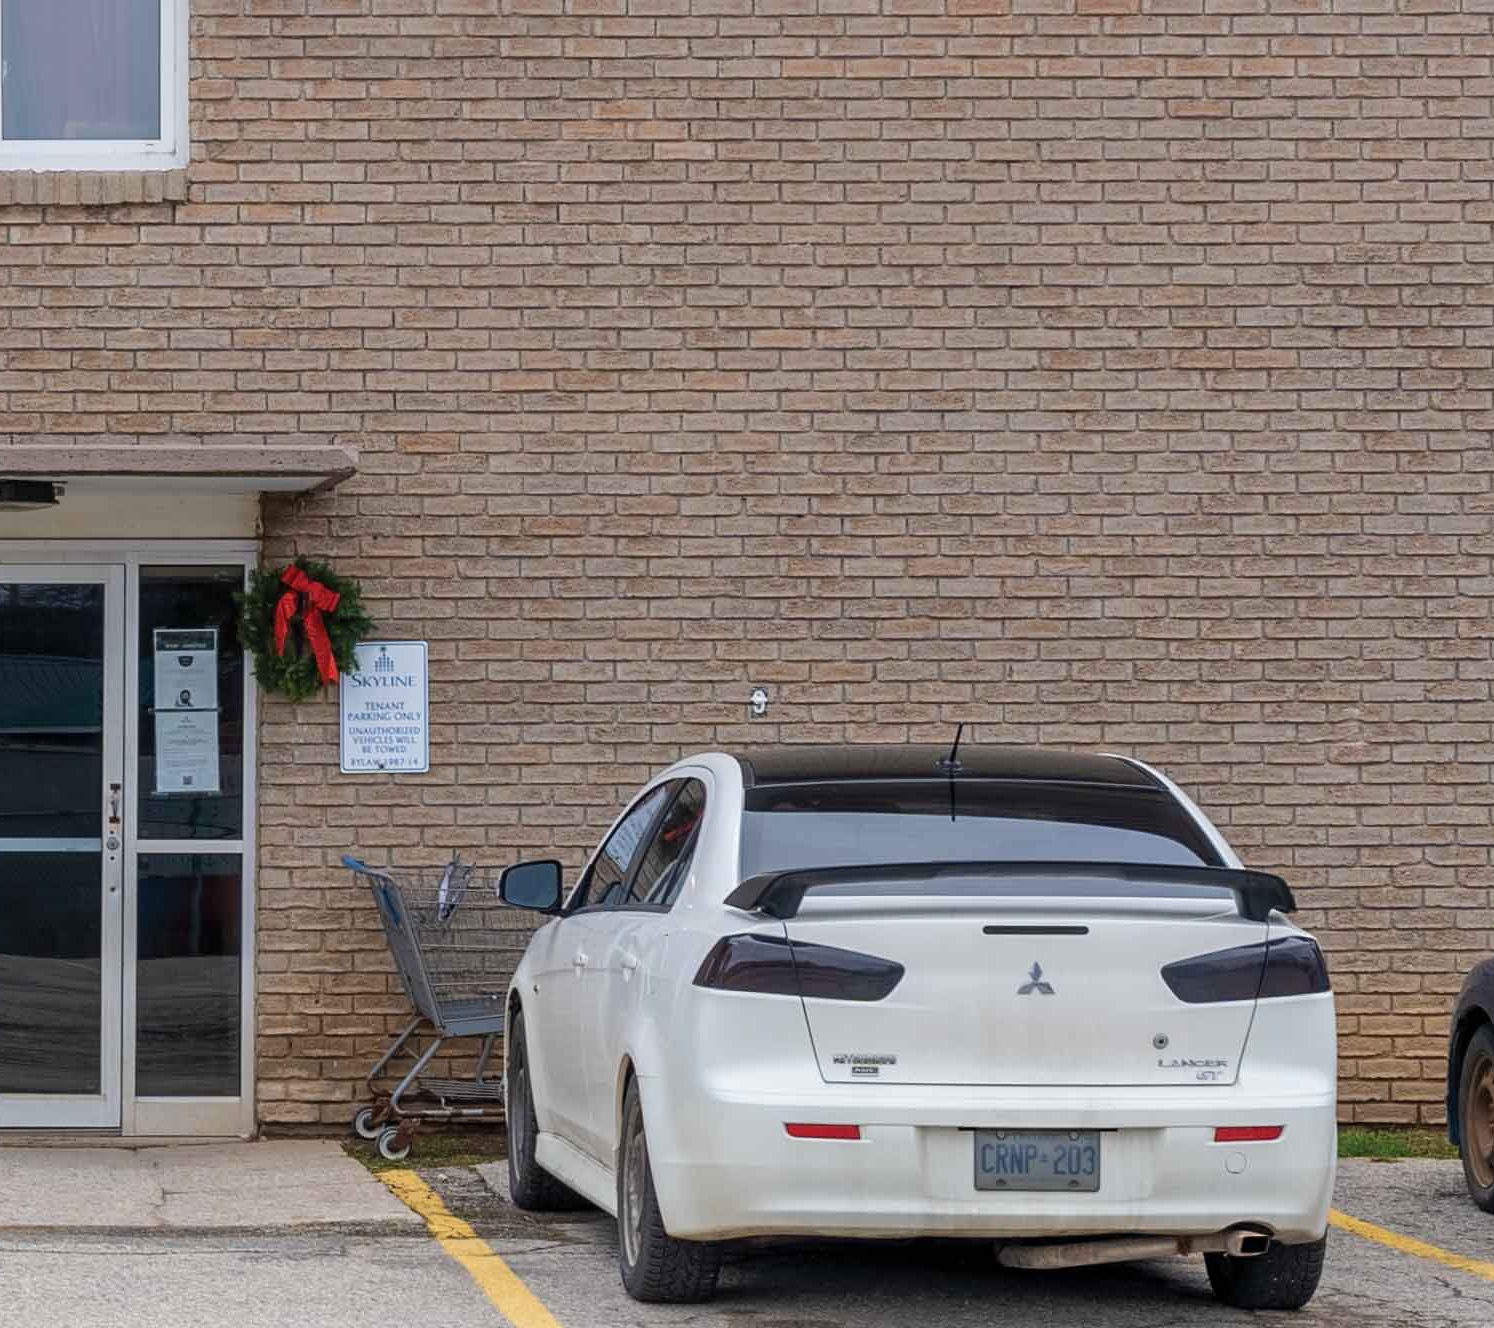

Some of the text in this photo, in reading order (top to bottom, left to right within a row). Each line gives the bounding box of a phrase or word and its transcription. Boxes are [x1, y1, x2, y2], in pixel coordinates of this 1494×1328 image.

[350, 673, 417, 688] SKYLINE
[364, 701, 405, 712] TENANT
[347, 712, 421, 721] PARKING ONLY
[348, 726, 420, 736] UNAUTHORIZED
[353, 735, 417, 745] VEHICLES WILL
[362, 745, 406, 754] BE TOWED
[350, 758, 380, 767] BYLAW
[980, 1143, 1096, 1176] CRNP 203
